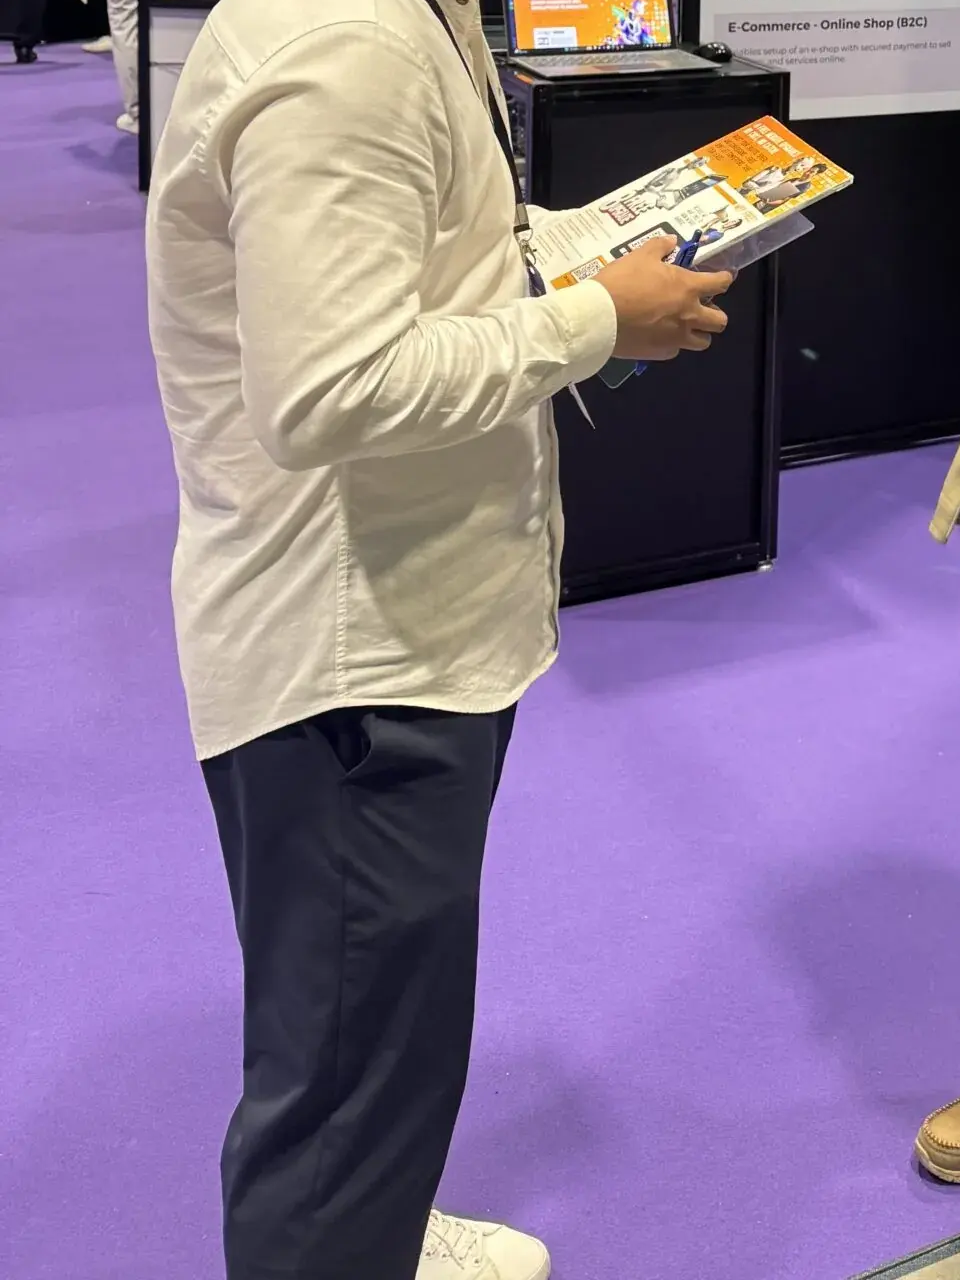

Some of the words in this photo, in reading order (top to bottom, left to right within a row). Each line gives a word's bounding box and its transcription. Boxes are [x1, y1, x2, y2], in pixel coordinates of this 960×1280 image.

[728, 21, 810, 33] E-Commerce
[820, 19, 862, 31] Online
[864, 18, 894, 31] Shop
[897, 17, 928, 29] (B2C)
[763, 47, 787, 57] setup
[789, 45, 798, 55] of
[799, 46, 809, 55] an
[811, 45, 840, 55] e-shop
[841, 45, 859, 53] with
[860, 43, 892, 52] secured
[893, 42, 928, 52] payment
[930, 41, 937, 50] to
[938, 40, 952, 49] sell
[786, 56, 818, 65] services
[819, 55, 846, 63] online
